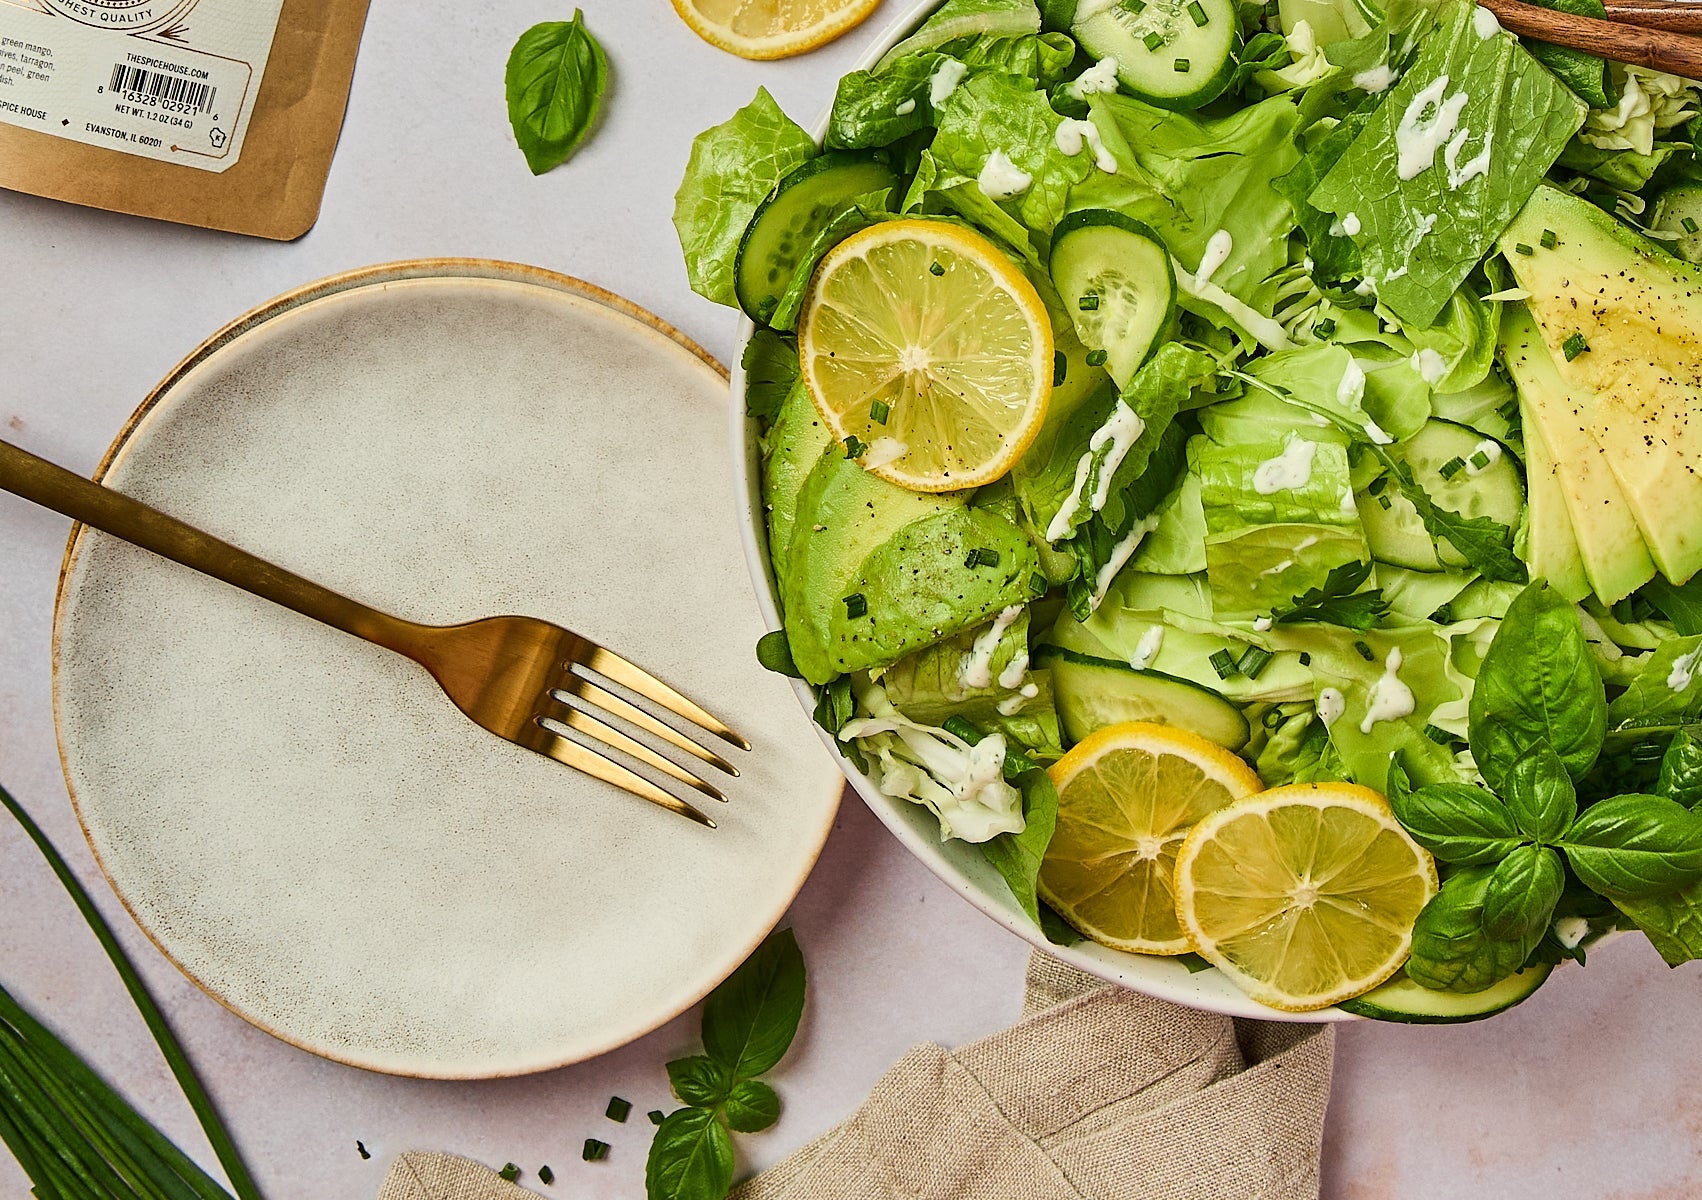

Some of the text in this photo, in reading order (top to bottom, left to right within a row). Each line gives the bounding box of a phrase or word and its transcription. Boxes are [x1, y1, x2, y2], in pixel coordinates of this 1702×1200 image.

[100, 8, 153, 23] QUALITY
[1, 37, 24, 48] green
[26, 70, 50, 82] green
[126, 52, 209, 80] THESPICEHOUSE.COM
[20, 106, 48, 120] HOUSE
[96, 85, 219, 122] 8 16328 02921 6
[114, 103, 193, 130] NET WT. 1.2 OZ (34 G)
[85, 122, 163, 148] EVANSTON, IL 60201
